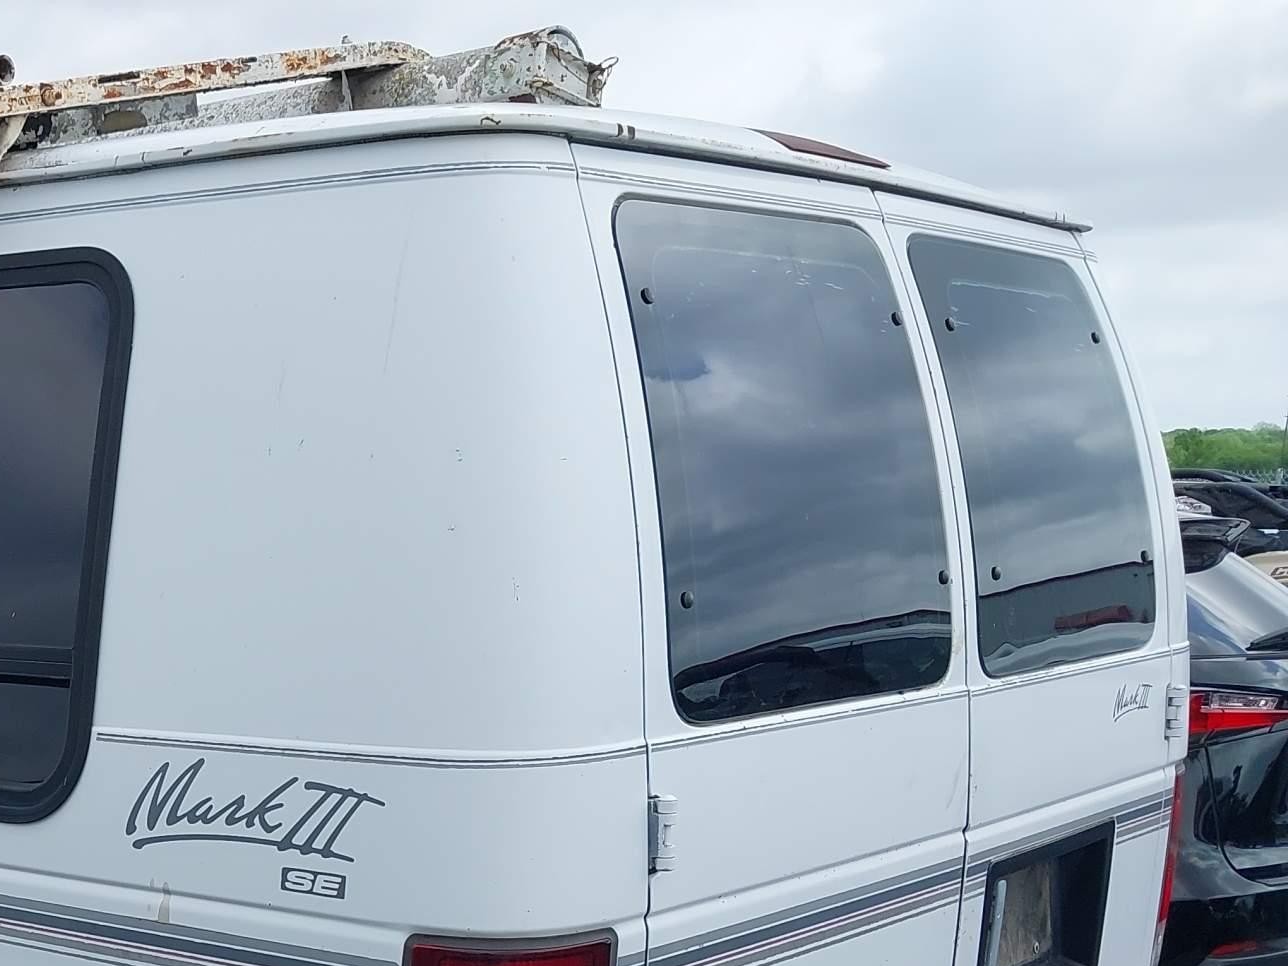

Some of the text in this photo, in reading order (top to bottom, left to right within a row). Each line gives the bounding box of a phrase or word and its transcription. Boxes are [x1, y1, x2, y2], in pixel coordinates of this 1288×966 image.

[125, 757, 386, 859] Mark III
[283, 869, 344, 898] SE
